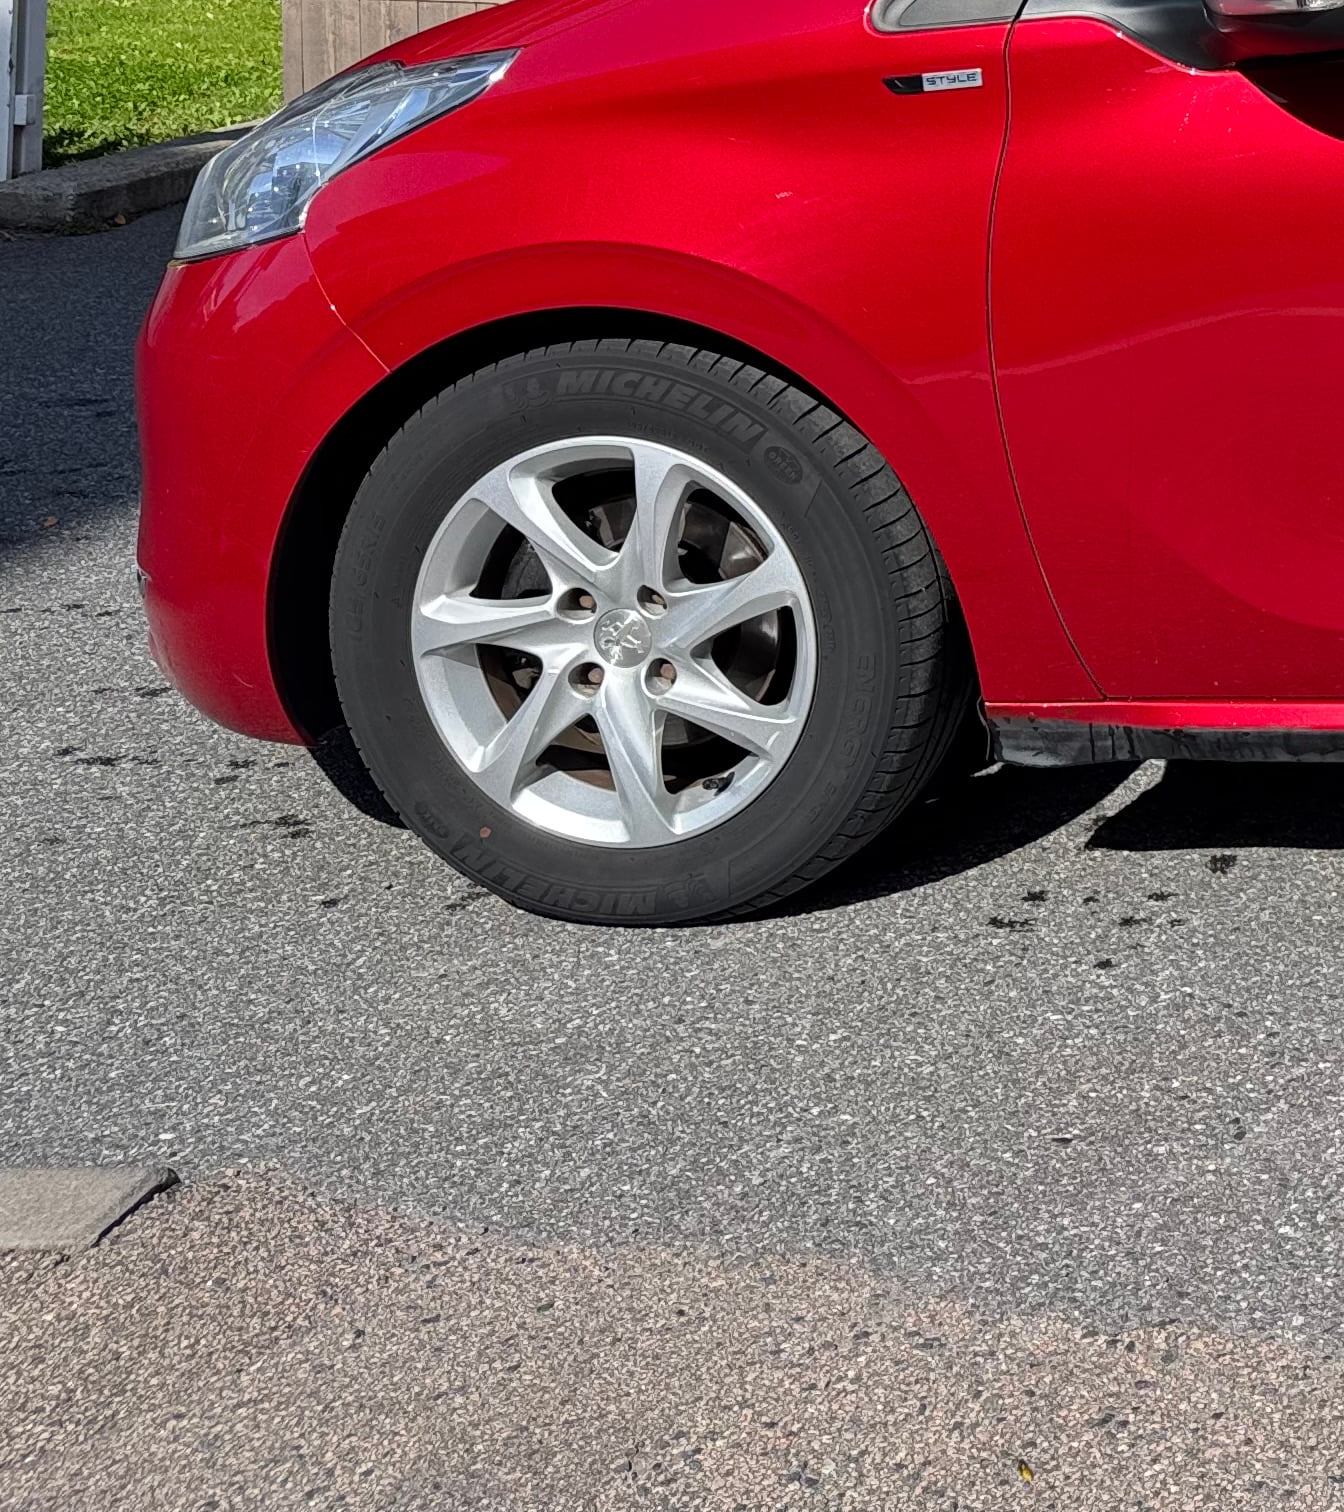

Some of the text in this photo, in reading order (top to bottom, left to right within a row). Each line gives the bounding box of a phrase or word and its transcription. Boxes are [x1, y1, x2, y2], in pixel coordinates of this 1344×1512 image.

[926, 73, 977, 86] STYLE
[556, 369, 766, 442] MICHELIN
[838, 654, 877, 779] ENERG
[452, 837, 657, 915] MICHELIN
